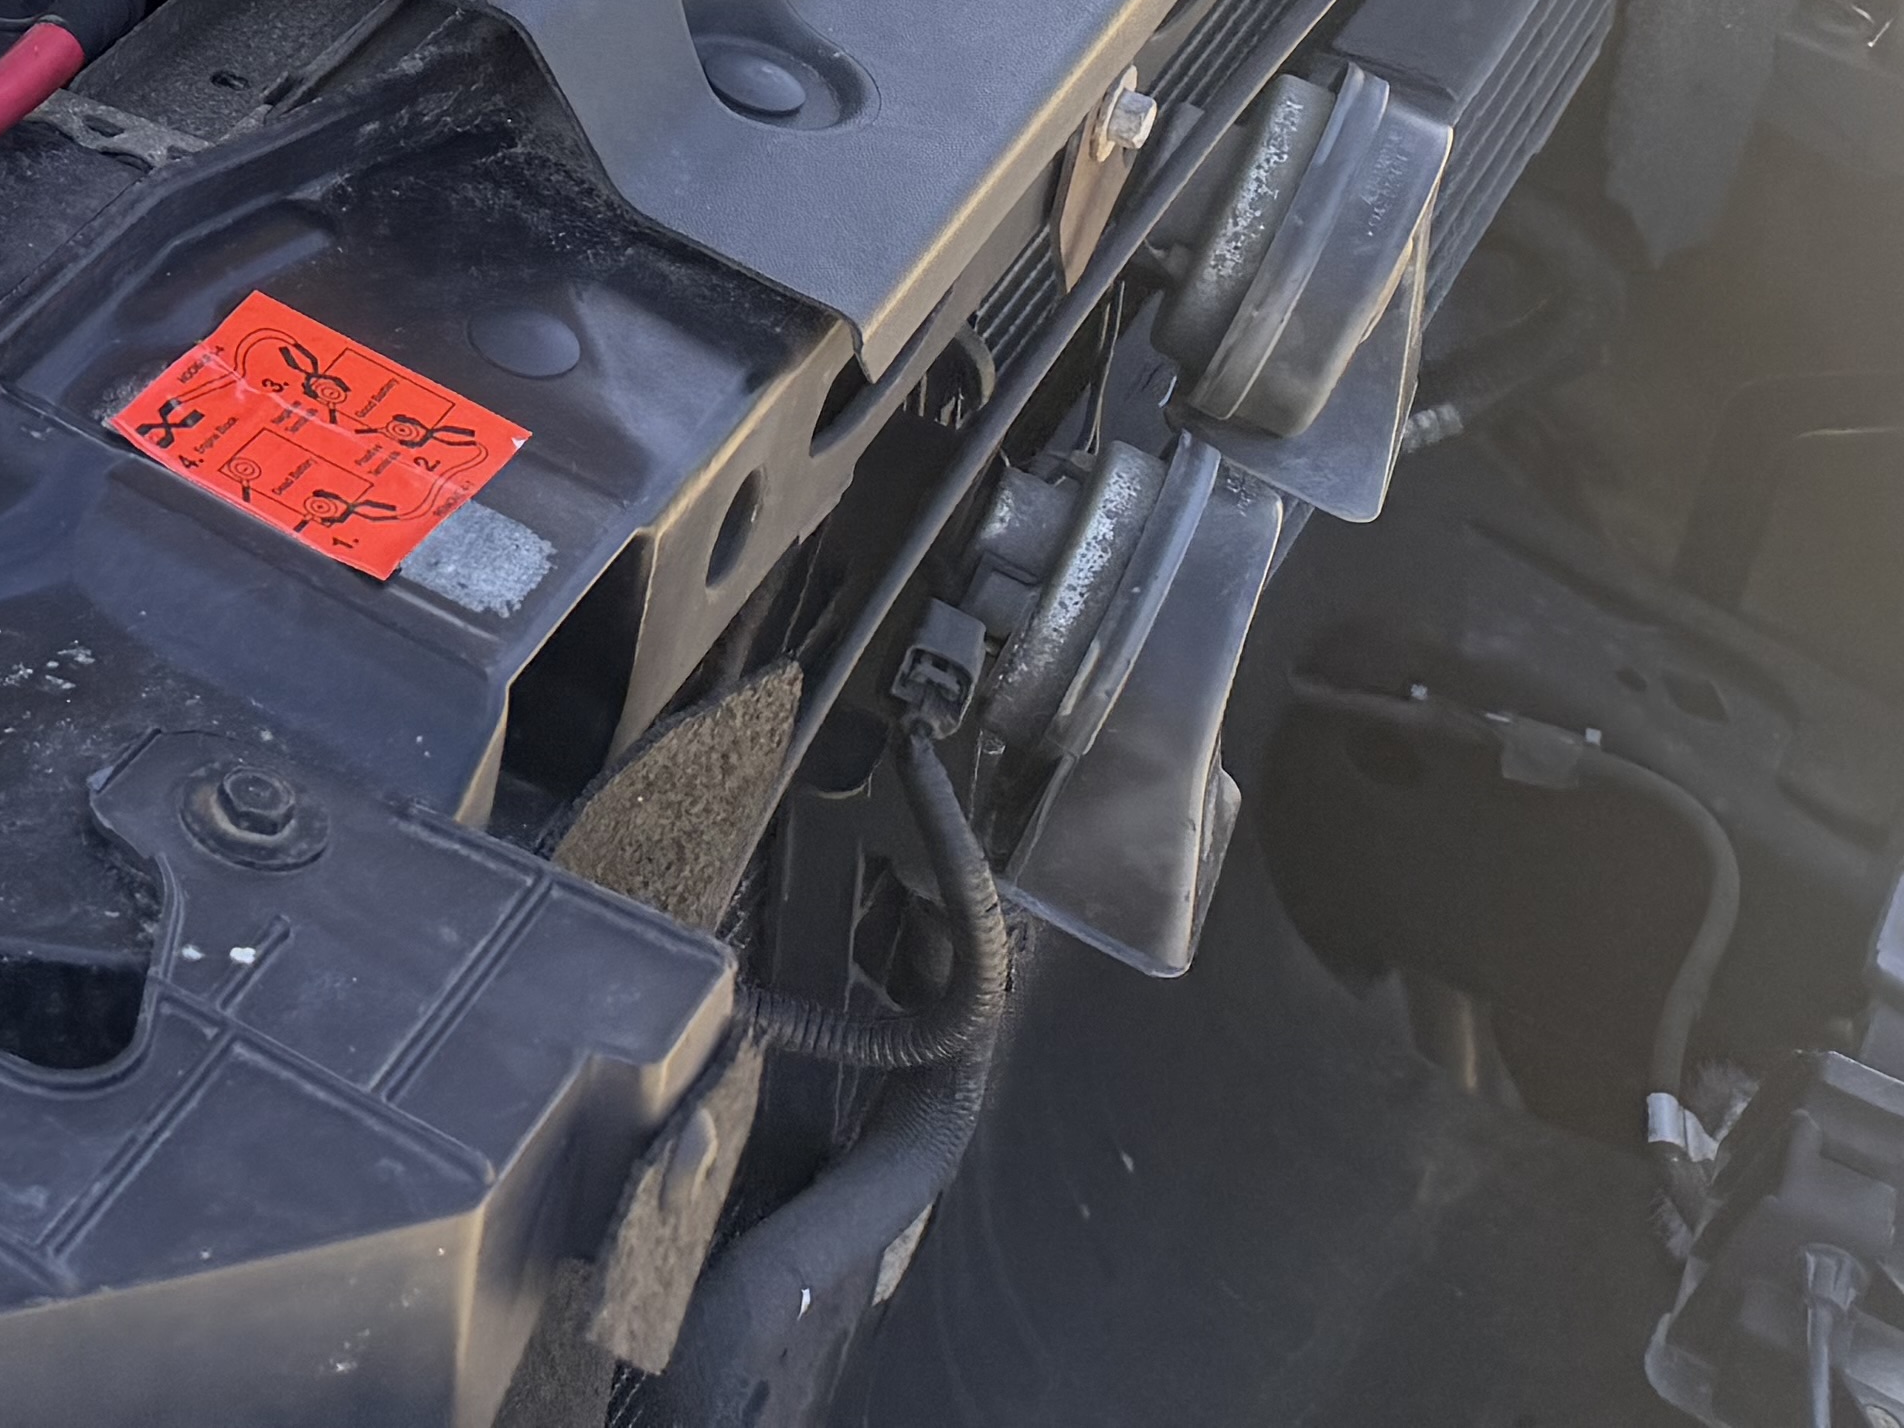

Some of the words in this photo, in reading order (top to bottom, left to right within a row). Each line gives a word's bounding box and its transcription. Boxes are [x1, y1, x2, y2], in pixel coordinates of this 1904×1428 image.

[260, 377, 290, 394] 3.
[177, 453, 205, 470] 4.
[412, 455, 441, 473] 2.
[331, 535, 360, 550] 1.
